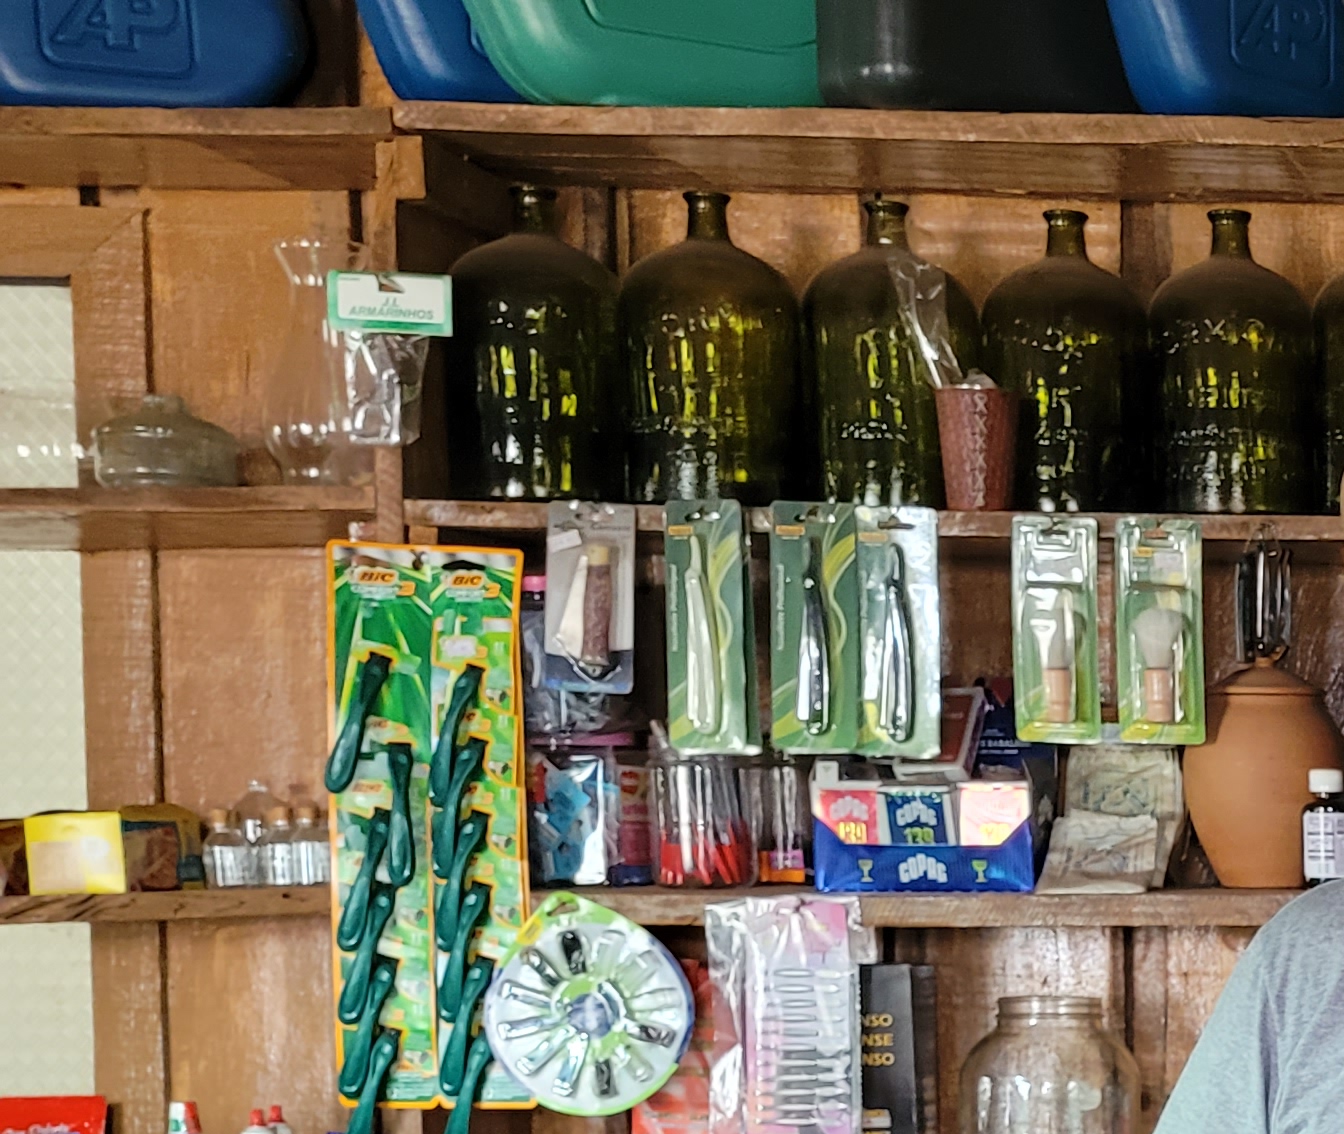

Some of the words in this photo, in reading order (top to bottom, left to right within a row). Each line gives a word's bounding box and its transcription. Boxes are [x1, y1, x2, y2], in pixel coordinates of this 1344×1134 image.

[348, 305, 434, 321] ARMARINHOS
[359, 572, 393, 584] BIC
[452, 575, 482, 586] BIC
[898, 852, 949, 884] COPAG
